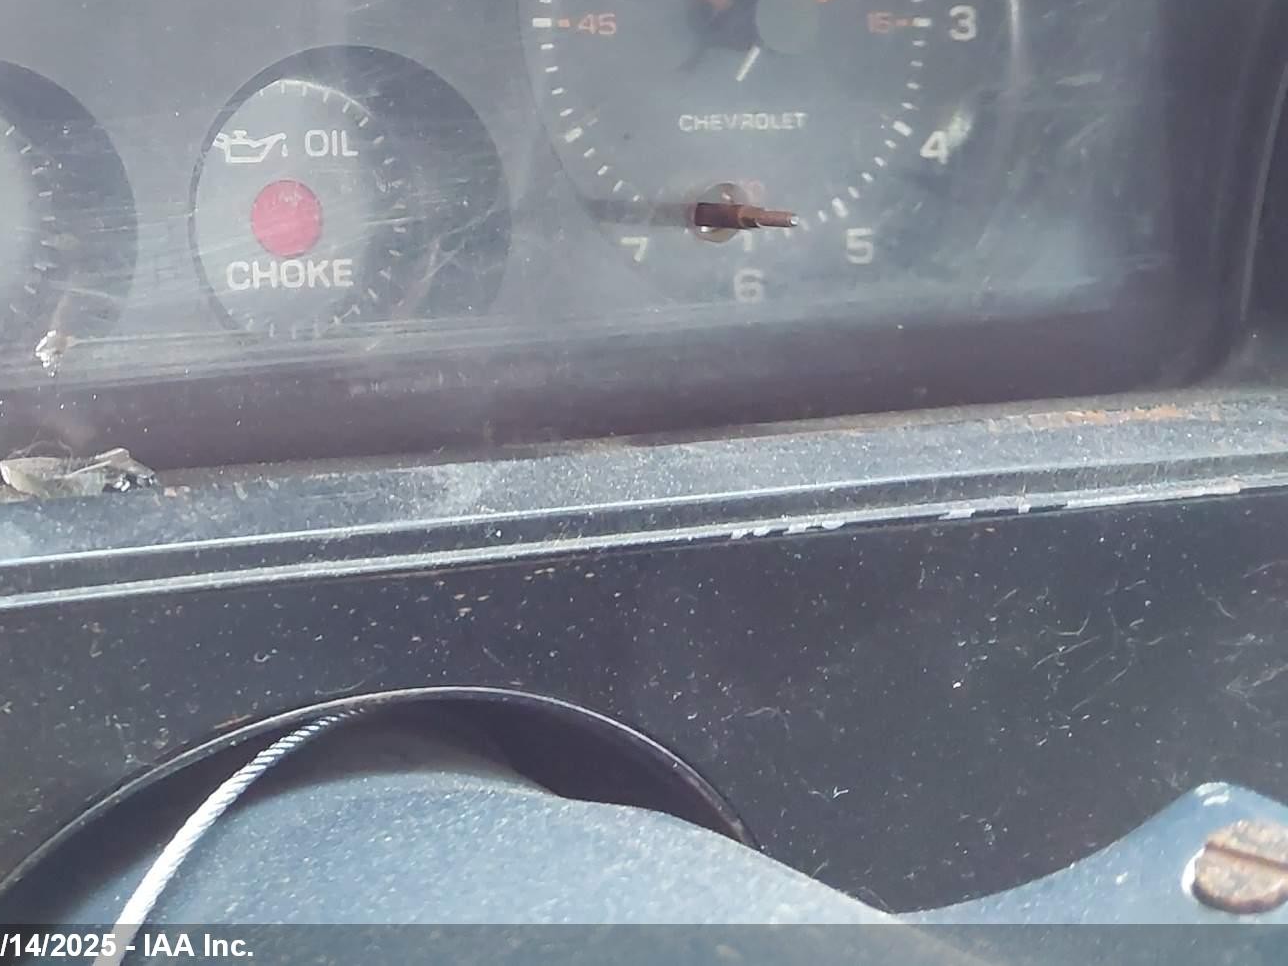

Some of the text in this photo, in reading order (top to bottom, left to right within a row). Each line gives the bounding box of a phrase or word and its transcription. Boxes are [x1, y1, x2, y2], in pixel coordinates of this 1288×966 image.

[577, 13, 617, 35] 45
[949, 5, 977, 41] 3
[679, 113, 808, 131] CHEVROLET
[304, 130, 359, 157] OIL
[920, 130, 949, 164] 4
[621, 237, 648, 262] 7
[846, 228, 874, 264] 5
[225, 259, 355, 290] CHOKE
[734, 268, 764, 302] 6
